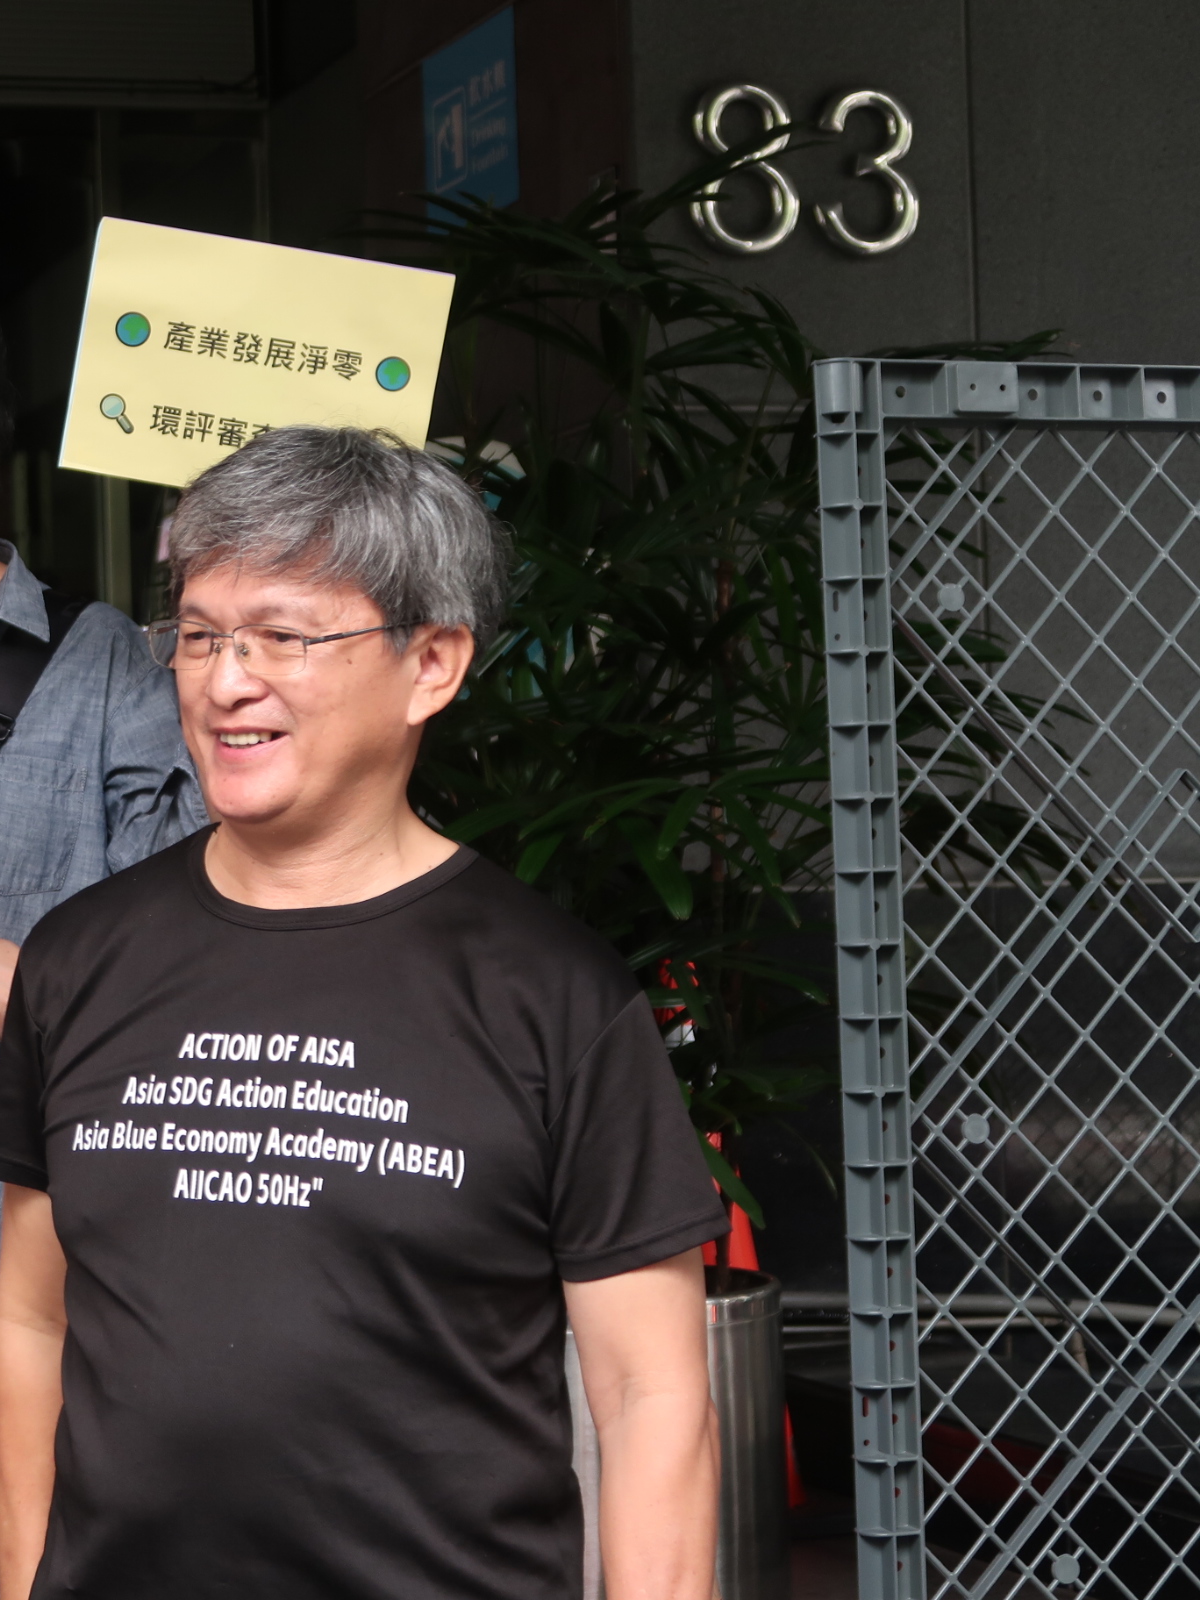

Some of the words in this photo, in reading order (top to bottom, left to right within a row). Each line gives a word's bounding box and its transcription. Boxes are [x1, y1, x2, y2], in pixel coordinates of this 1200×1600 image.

[691, 84, 920, 254] 83
[162, 320, 363, 381] 產業發展淨零
[178, 1032, 262, 1062] ACTION
[266, 1034, 300, 1063] OF
[299, 1036, 356, 1069] AISA
[122, 1074, 167, 1105] Asia
[169, 1077, 214, 1107] SDG
[215, 1076, 288, 1110] Action
[291, 1080, 410, 1124] Education
[72, 1121, 109, 1152] Asia
[111, 1120, 157, 1151] Blue
[160, 1122, 263, 1163] Economy
[264, 1127, 375, 1173] Academy
[377, 1137, 467, 1189] (ABEA)
[255, 1174, 325, 1208] 50Hz"
